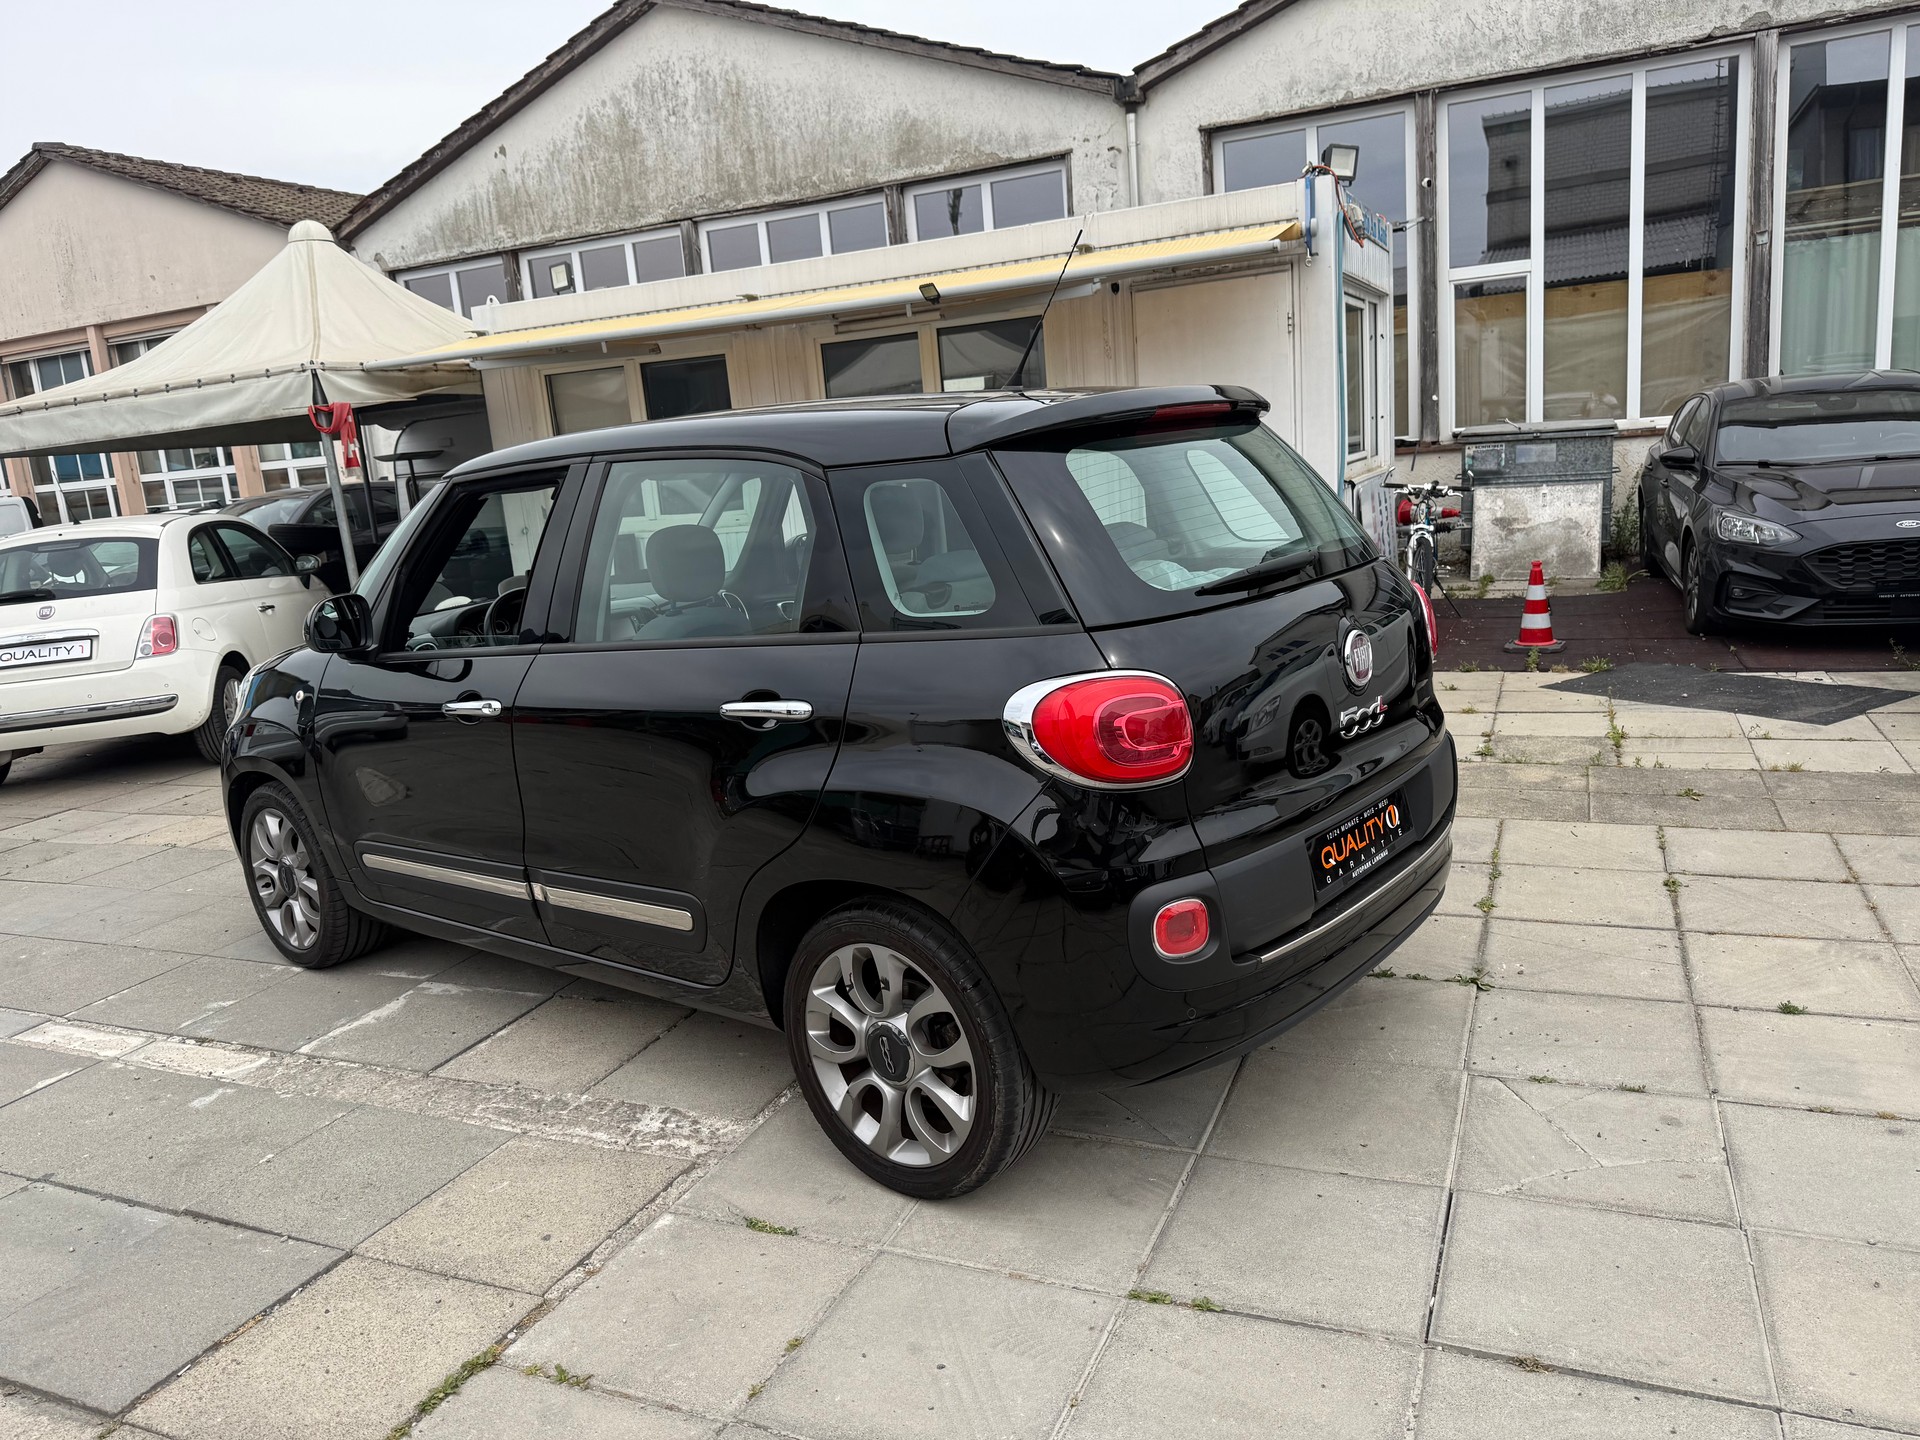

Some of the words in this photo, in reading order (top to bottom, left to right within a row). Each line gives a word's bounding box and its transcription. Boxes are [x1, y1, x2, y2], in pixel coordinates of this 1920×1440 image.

[0, 645, 75, 662] QUALITY
[79, 644, 84, 654] 1
[1353, 644, 1368, 672] FIAT
[1340, 695, 1388, 740] 500L
[1321, 812, 1385, 869] QUALITY
[1326, 828, 1341, 841] 12/24
[1341, 816, 1359, 832] MONATE
[1363, 808, 1375, 820] MOIS
[1378, 798, 1389, 808] MESI
[1327, 828, 1402, 883] GARANTIE
[1352, 860, 1372, 879] AUTOPARK
[1371, 849, 1389, 867] LANGNAU
